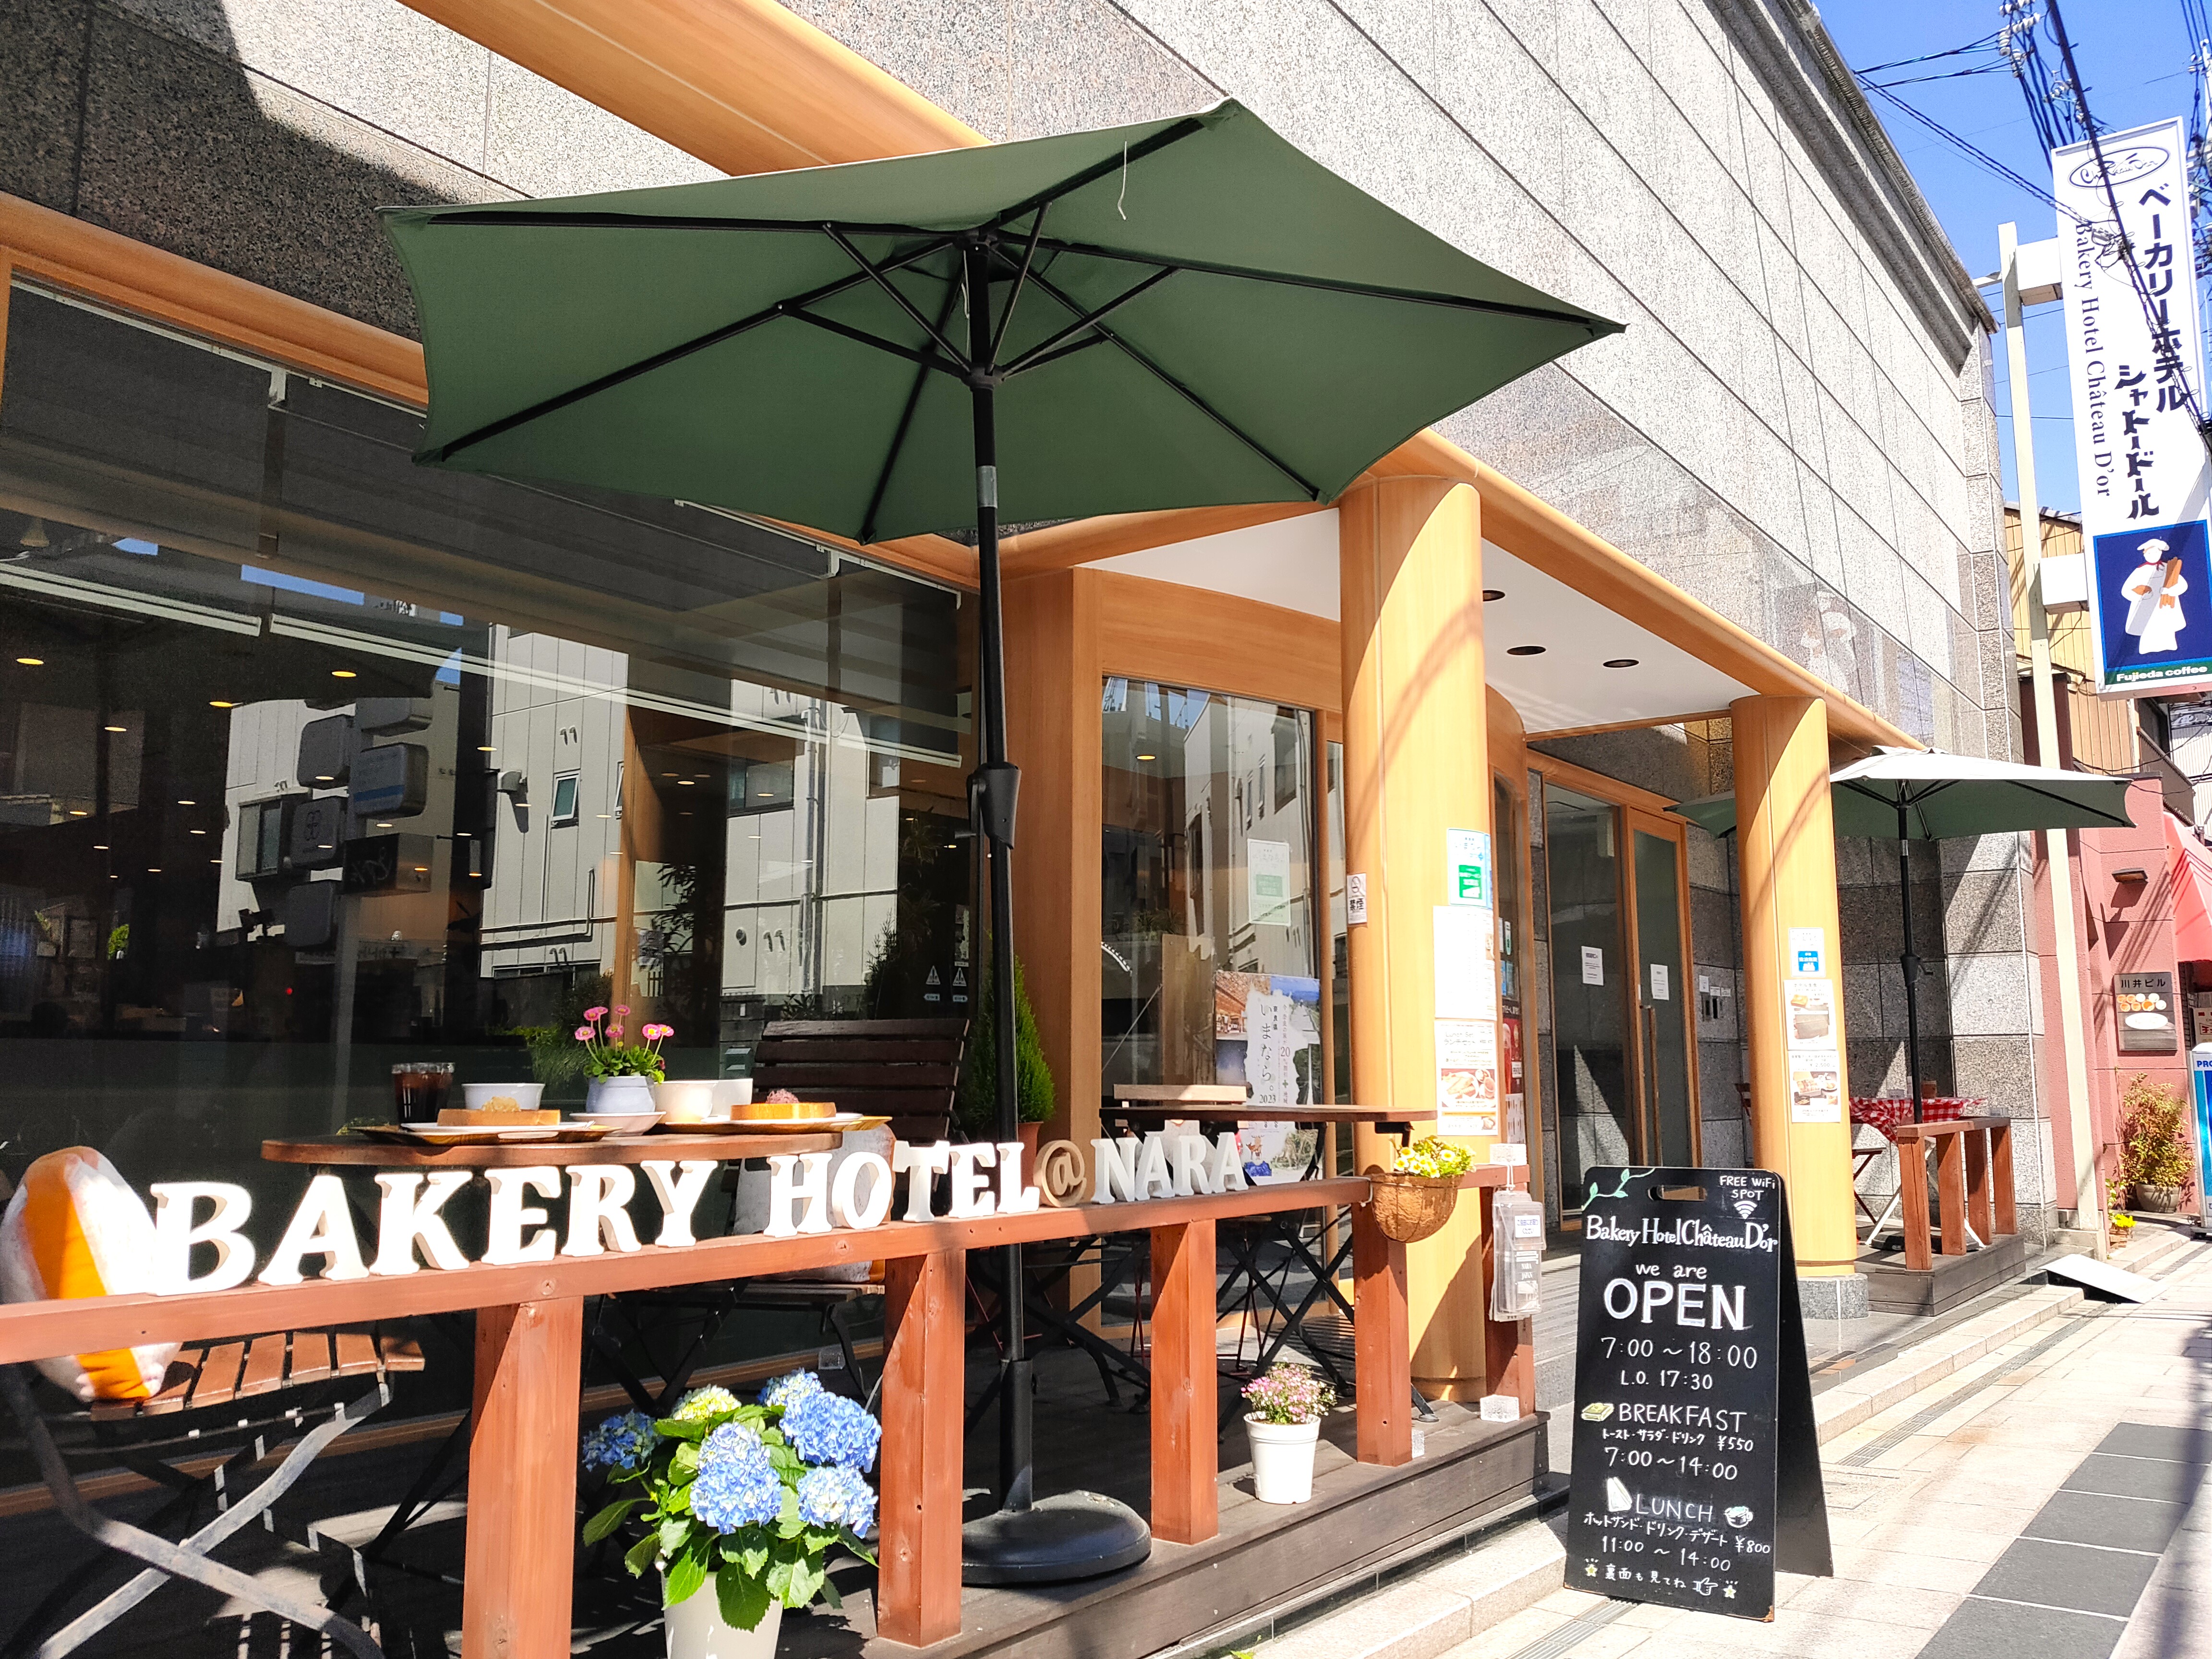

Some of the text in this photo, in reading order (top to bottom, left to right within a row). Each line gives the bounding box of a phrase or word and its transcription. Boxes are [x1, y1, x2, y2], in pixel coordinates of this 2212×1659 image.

[2074, 224, 2095, 289] Bakery
[2139, 183, 2187, 413] ベーカリーホテル
[2081, 296, 2104, 354] Hotel
[2087, 361, 2107, 445] Château
[2114, 365, 2159, 520] シャトードール
[2116, 666, 2207, 682] Fujieda coffee
[1350, 898, 1364, 911] 禁煙
[2121, 978, 2165, 988] 川井ビル
[1259, 1094, 1276, 1104] 2023
[1719, 1175, 1776, 1189] FREE WiFi
[1731, 1189, 1764, 1201] SPOT
[151, 1160, 718, 1296] BAKERY
[763, 1141, 1040, 1238] HOTEL
[1091, 1131, 1249, 1204] NARA
[1586, 1214, 1641, 1247] Bakery
[1642, 1217, 1681, 1245] Hotel
[1682, 1218, 1745, 1249] Château
[1635, 1264, 1707, 1279] we are
[1604, 1278, 1748, 1330] OPEN
[1601, 1337, 1653, 1358] 7:00
[1689, 1341, 1757, 1369] 18:00
[1621, 1370, 1713, 1390] L.O. 17:30
[1619, 1403, 1747, 1433] BREAKFAST
[1717, 1435, 1754, 1452] ¥550
[1605, 1447, 1652, 1467] 7:00
[1679, 1456, 1738, 1480] 14:00
[1636, 1493, 1713, 1523] LUNCH
[1602, 1536, 1644, 1553] 11:00
[1681, 1548, 1731, 1571] 14:00
[1735, 1535, 1770, 1554] ¥800
[1605, 1563, 1686, 1588] 裏面も見てね
